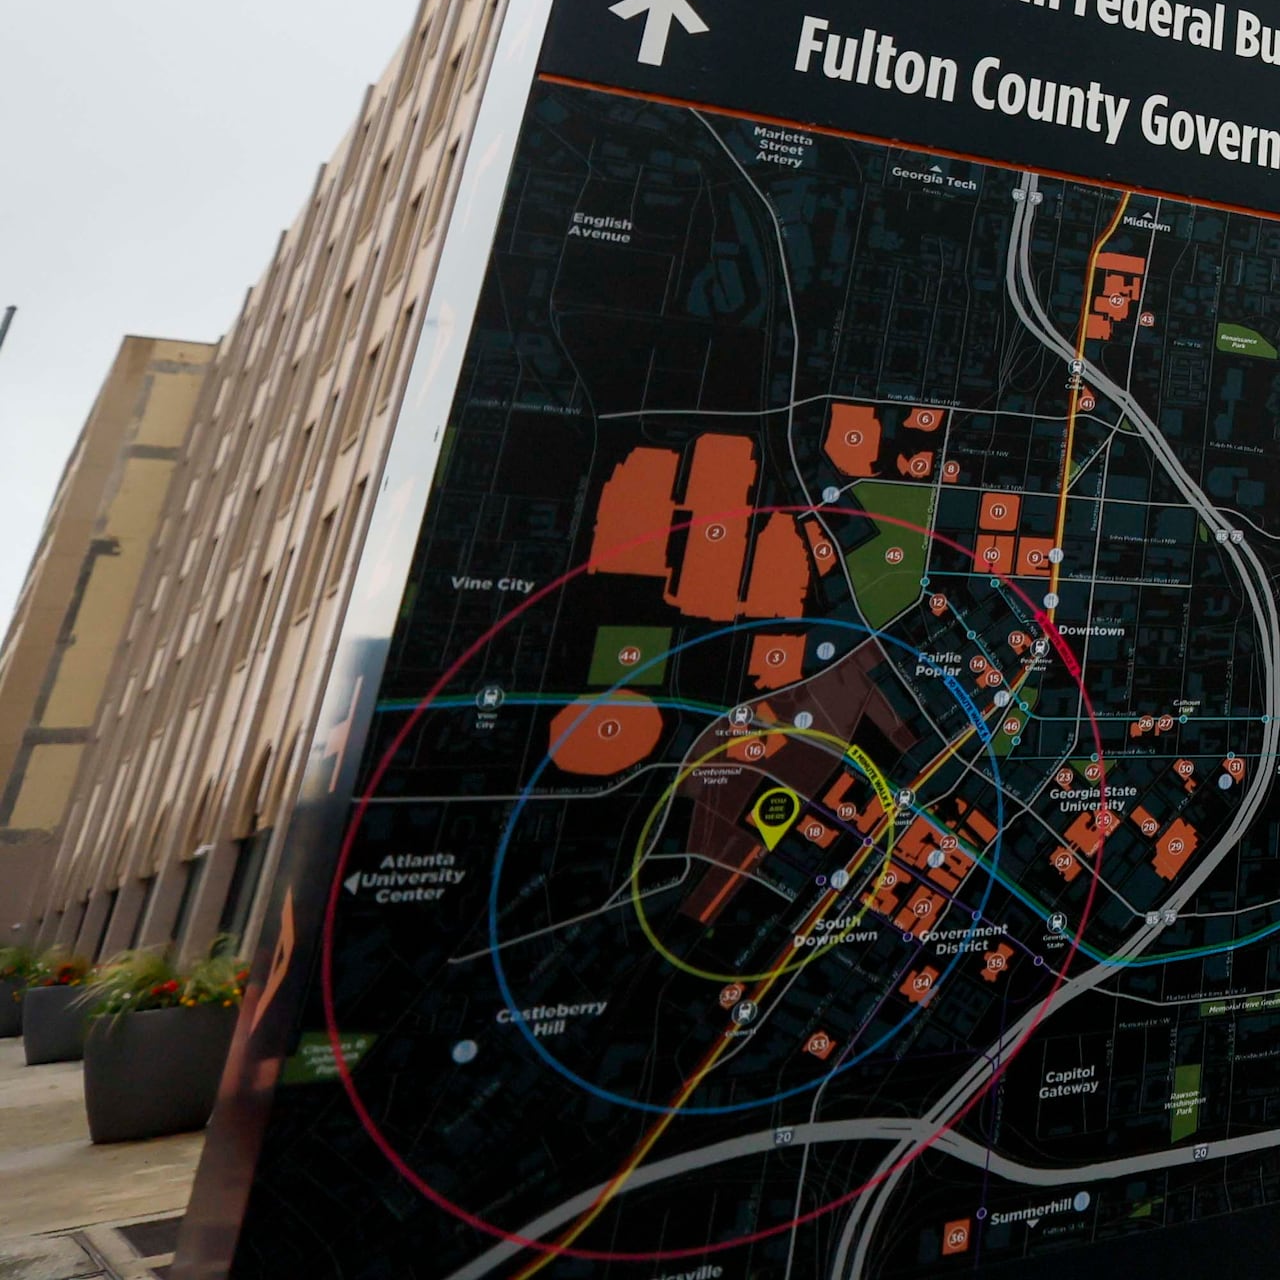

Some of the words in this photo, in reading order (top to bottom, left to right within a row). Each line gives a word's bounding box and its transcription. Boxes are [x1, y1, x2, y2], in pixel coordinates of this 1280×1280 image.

[793, 15, 958, 102] Fulton
[971, 56, 1130, 146] County
[753, 126, 813, 147] Marietta
[759, 139, 804, 156] Street
[755, 151, 802, 169] Artery
[892, 166, 943, 186] Georgia
[946, 176, 978, 191] Tech
[1030, 192, 1042, 203] 75
[573, 211, 633, 232] English
[1123, 216, 1172, 233] Midtown
[568, 224, 631, 244] Avenue
[1110, 295, 1124, 306] 42
[1141, 315, 1154, 325] 43
[1220, 333, 1259, 345] Renaissance
[1231, 341, 1246, 350] Park
[1082, 399, 1093, 409] 41
[921, 414, 930, 424] 6
[849, 433, 858, 443] 5
[915, 461, 924, 472] 7
[993, 506, 1004, 517] 11
[711, 527, 721, 537] 2
[1215, 531, 1228, 541] 85
[1231, 532, 1243, 542] 75
[818, 546, 828, 555] 4
[886, 550, 902, 561] 45
[985, 550, 999, 560] 10
[1031, 553, 1039, 563] 9
[451, 575, 493, 592] Vine
[497, 577, 536, 594] City
[932, 597, 945, 607] 12
[1058, 624, 1126, 637] Downtown
[1011, 634, 1022, 644] 13
[619, 651, 639, 662] 44
[771, 653, 780, 663] 3
[917, 651, 963, 664] Fairlie
[972, 660, 985, 669] 14
[915, 665, 963, 678] Poplar
[988, 673, 1000, 684] 15
[954, 685, 973, 712] MINUTE
[970, 711, 986, 733] WALK
[477, 711, 498, 721] Vine
[476, 721, 495, 730] City
[1004, 721, 1019, 732] 46
[1140, 718, 1153, 728] 26
[1160, 718, 1173, 728] 27
[748, 746, 762, 756] 16
[692, 767, 742, 777] Centennial
[1179, 764, 1192, 774] 30
[1230, 762, 1242, 771] 31
[856, 754, 877, 781] MINUTE
[873, 779, 890, 802] WALK
[1058, 771, 1072, 782] 23
[1086, 767, 1100, 778] 47
[703, 776, 729, 785] Yards
[1049, 788, 1101, 801] Georgia
[1103, 786, 1138, 798] State
[768, 805, 785, 813] ARE
[840, 806, 853, 817] 19
[1059, 800, 1126, 813] University
[764, 813, 786, 821] HERE
[808, 826, 821, 837] 18
[1143, 821, 1156, 832] 28
[942, 838, 957, 849] 22
[1169, 841, 1183, 852] 29
[379, 851, 456, 870] Atlanta
[1058, 856, 1071, 867] 24
[361, 869, 467, 889] University
[880, 875, 896, 886] 20
[374, 886, 446, 905] Center
[915, 903, 929, 914] 21
[814, 916, 862, 932] South
[1146, 915, 1159, 926] 85
[1164, 913, 1177, 924] 75
[918, 923, 1009, 943] Government
[793, 930, 879, 948] Downtown
[935, 940, 990, 956] District
[1046, 942, 1065, 950] State
[988, 958, 1005, 969] 35
[914, 977, 931, 989] 34
[722, 990, 739, 1002] 32
[496, 1000, 609, 1025] Castleberry
[1208, 1002, 1241, 1014] Memorial
[1241, 1000, 1260, 1010] Drive
[533, 1018, 567, 1037] Hill
[810, 1037, 826, 1050] 33
[1045, 1064, 1096, 1084] Capitol
[1038, 1080, 1100, 1100] Gateway
[1164, 1096, 1208, 1110] Washington
[1176, 1106, 1194, 1116] Park
[776, 1131, 792, 1143] 20
[1194, 1148, 1208, 1159] 20
[990, 1196, 1072, 1227] Summerhill
[950, 1230, 966, 1245] 36
